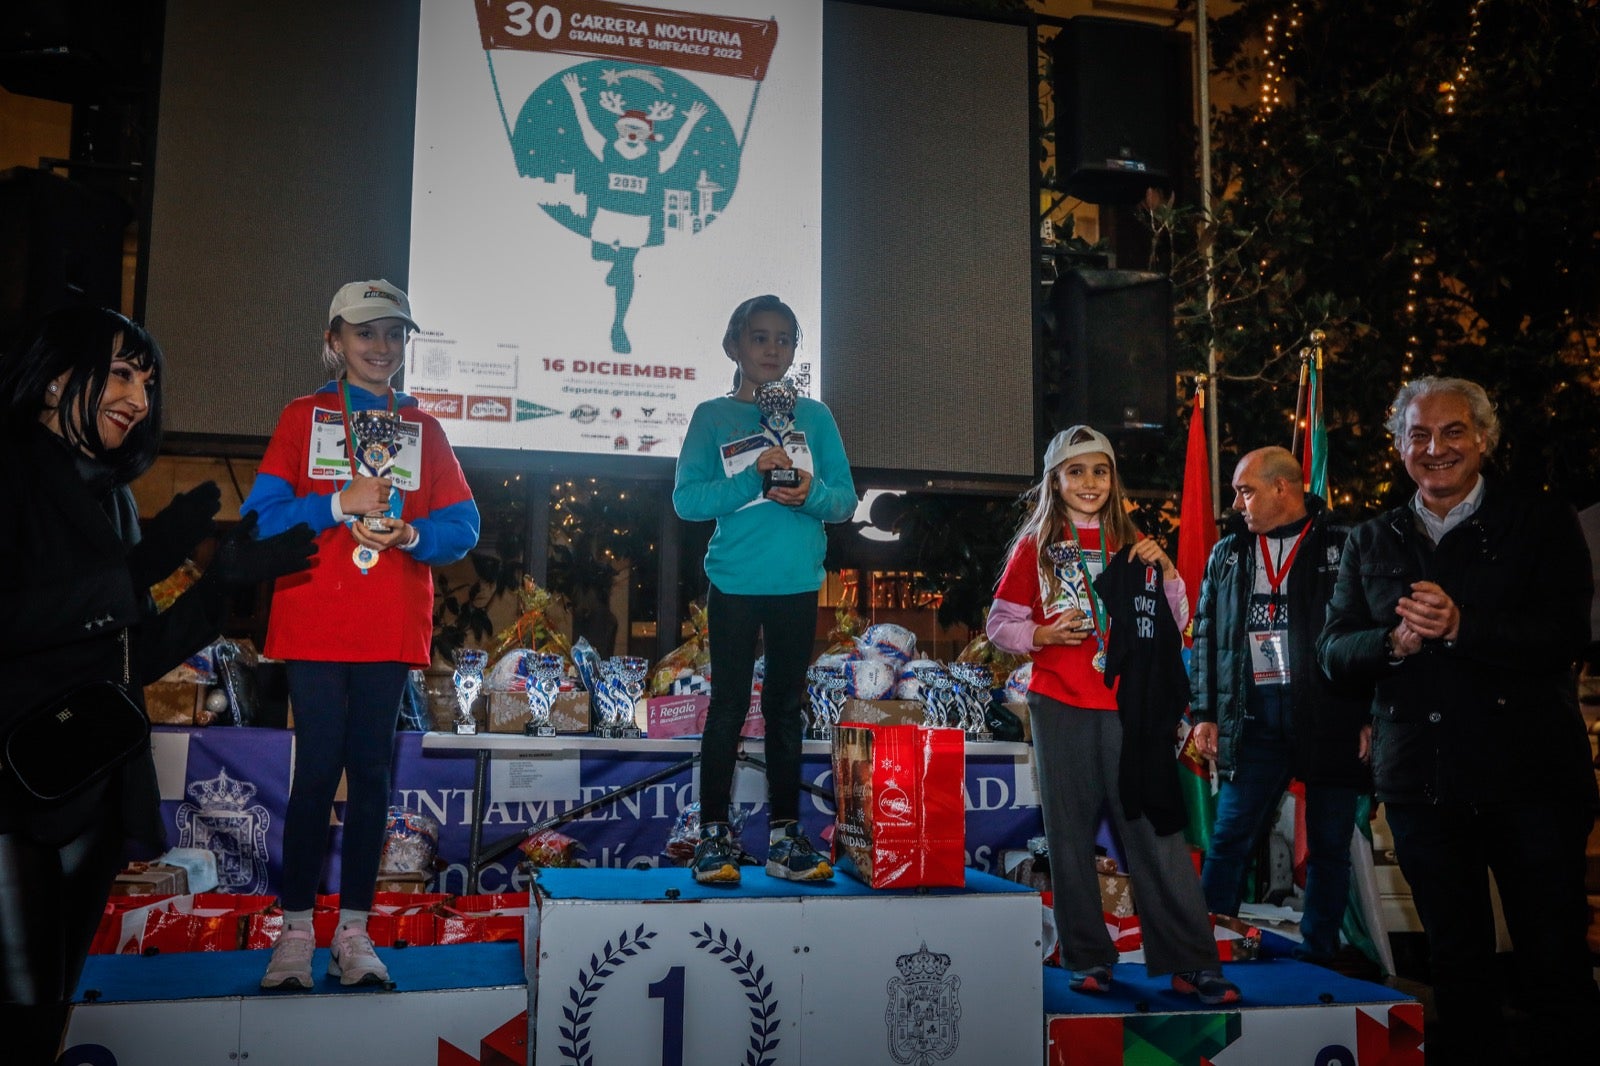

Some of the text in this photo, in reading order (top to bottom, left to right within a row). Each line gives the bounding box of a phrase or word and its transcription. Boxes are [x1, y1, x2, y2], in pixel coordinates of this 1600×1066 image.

[504, 1, 742, 47] 30 CARRERA NOCTURNA
[568, 29, 743, 60] GRANADA DE DISFRACES 2022
[542, 358, 697, 381] 16 DICIEMBRE
[660, 702, 696, 718] Regalo
[839, 823, 865, 836] EFRESCA
[647, 966, 686, 1066] 1
